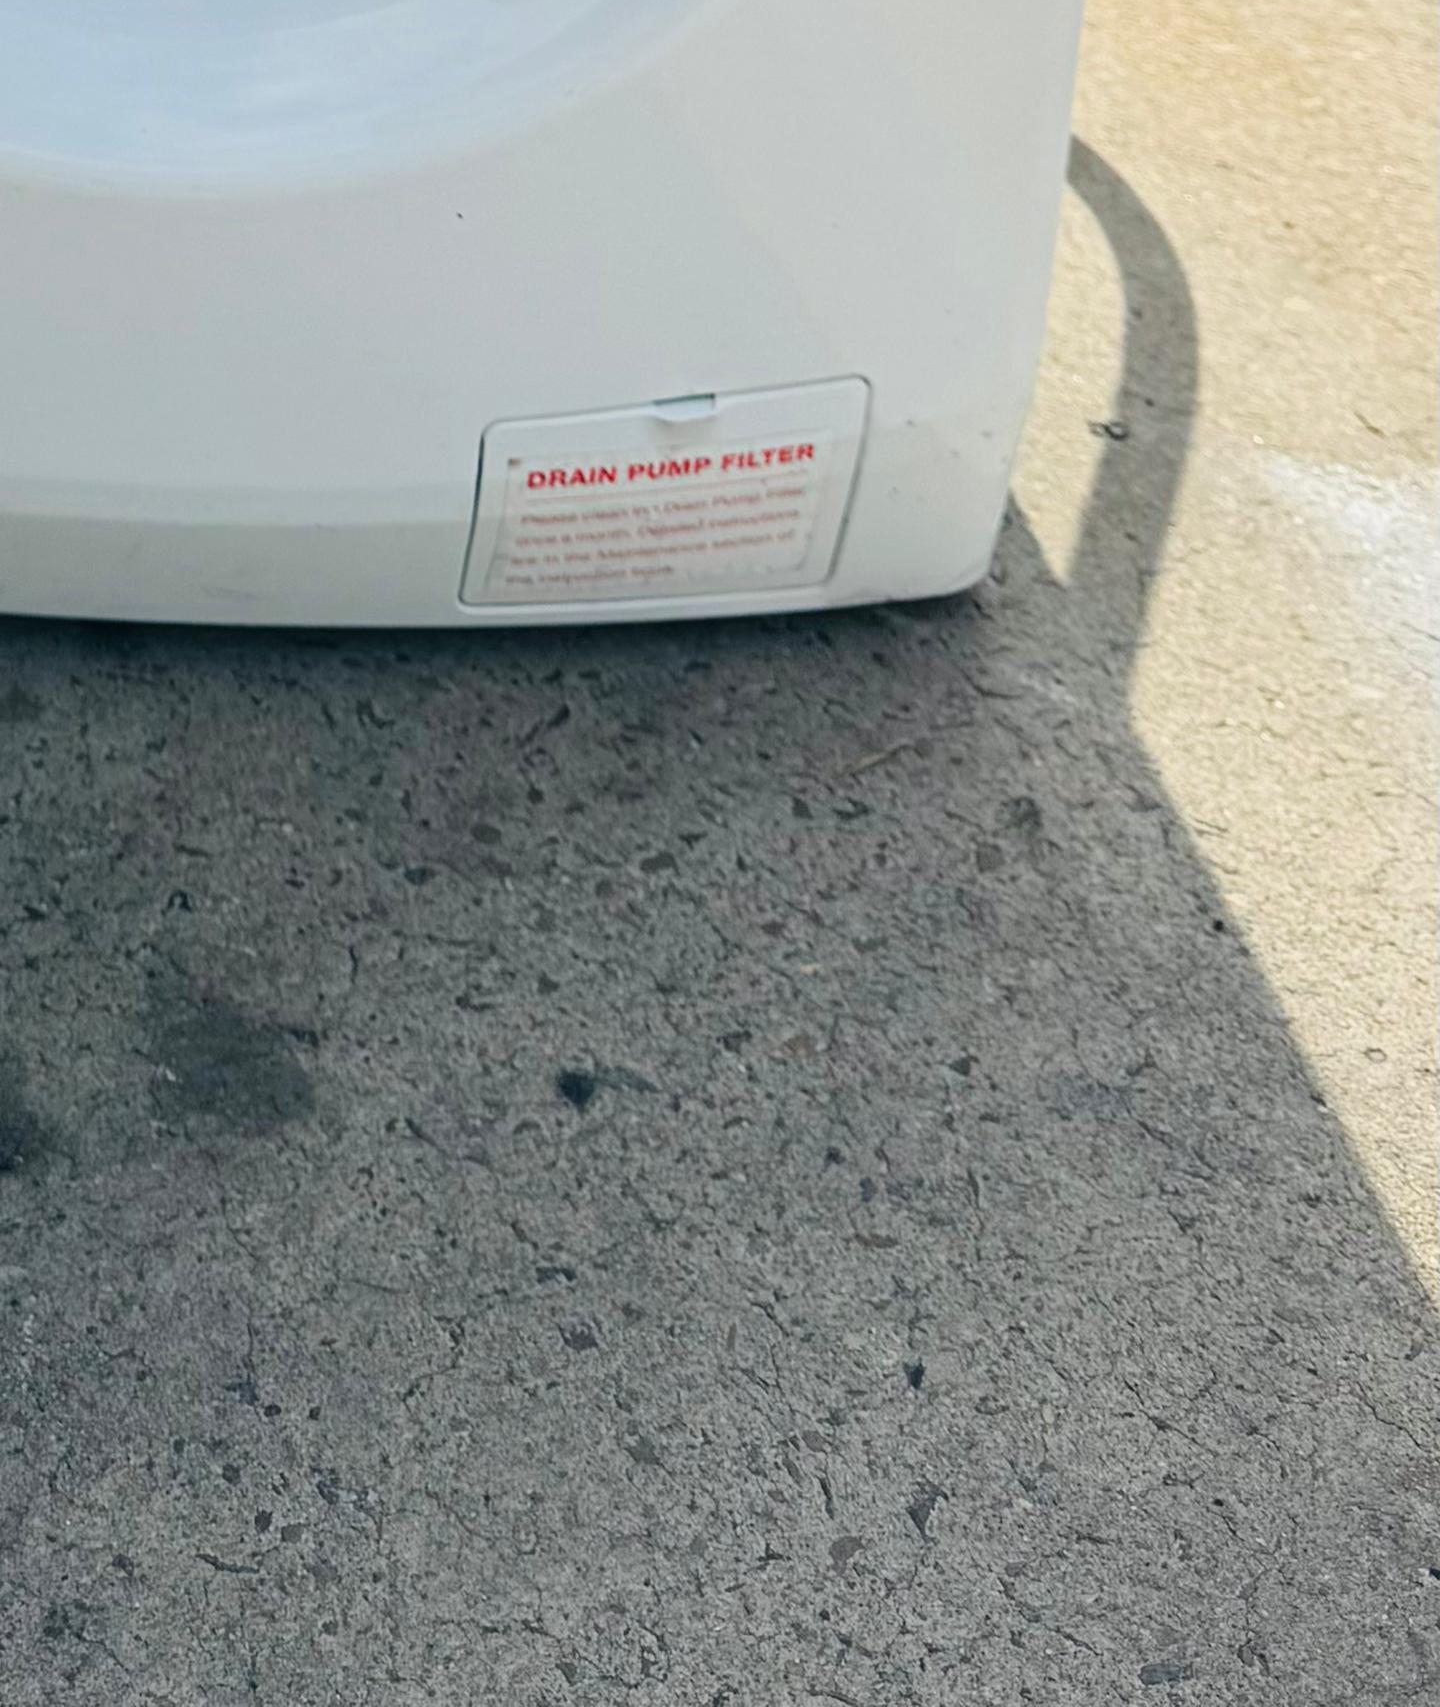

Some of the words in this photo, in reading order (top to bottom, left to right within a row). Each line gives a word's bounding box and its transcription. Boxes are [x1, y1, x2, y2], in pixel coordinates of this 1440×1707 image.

[527, 466, 618, 490] DRAIN
[627, 457, 712, 481] PUMP
[721, 443, 816, 471] FILTER
